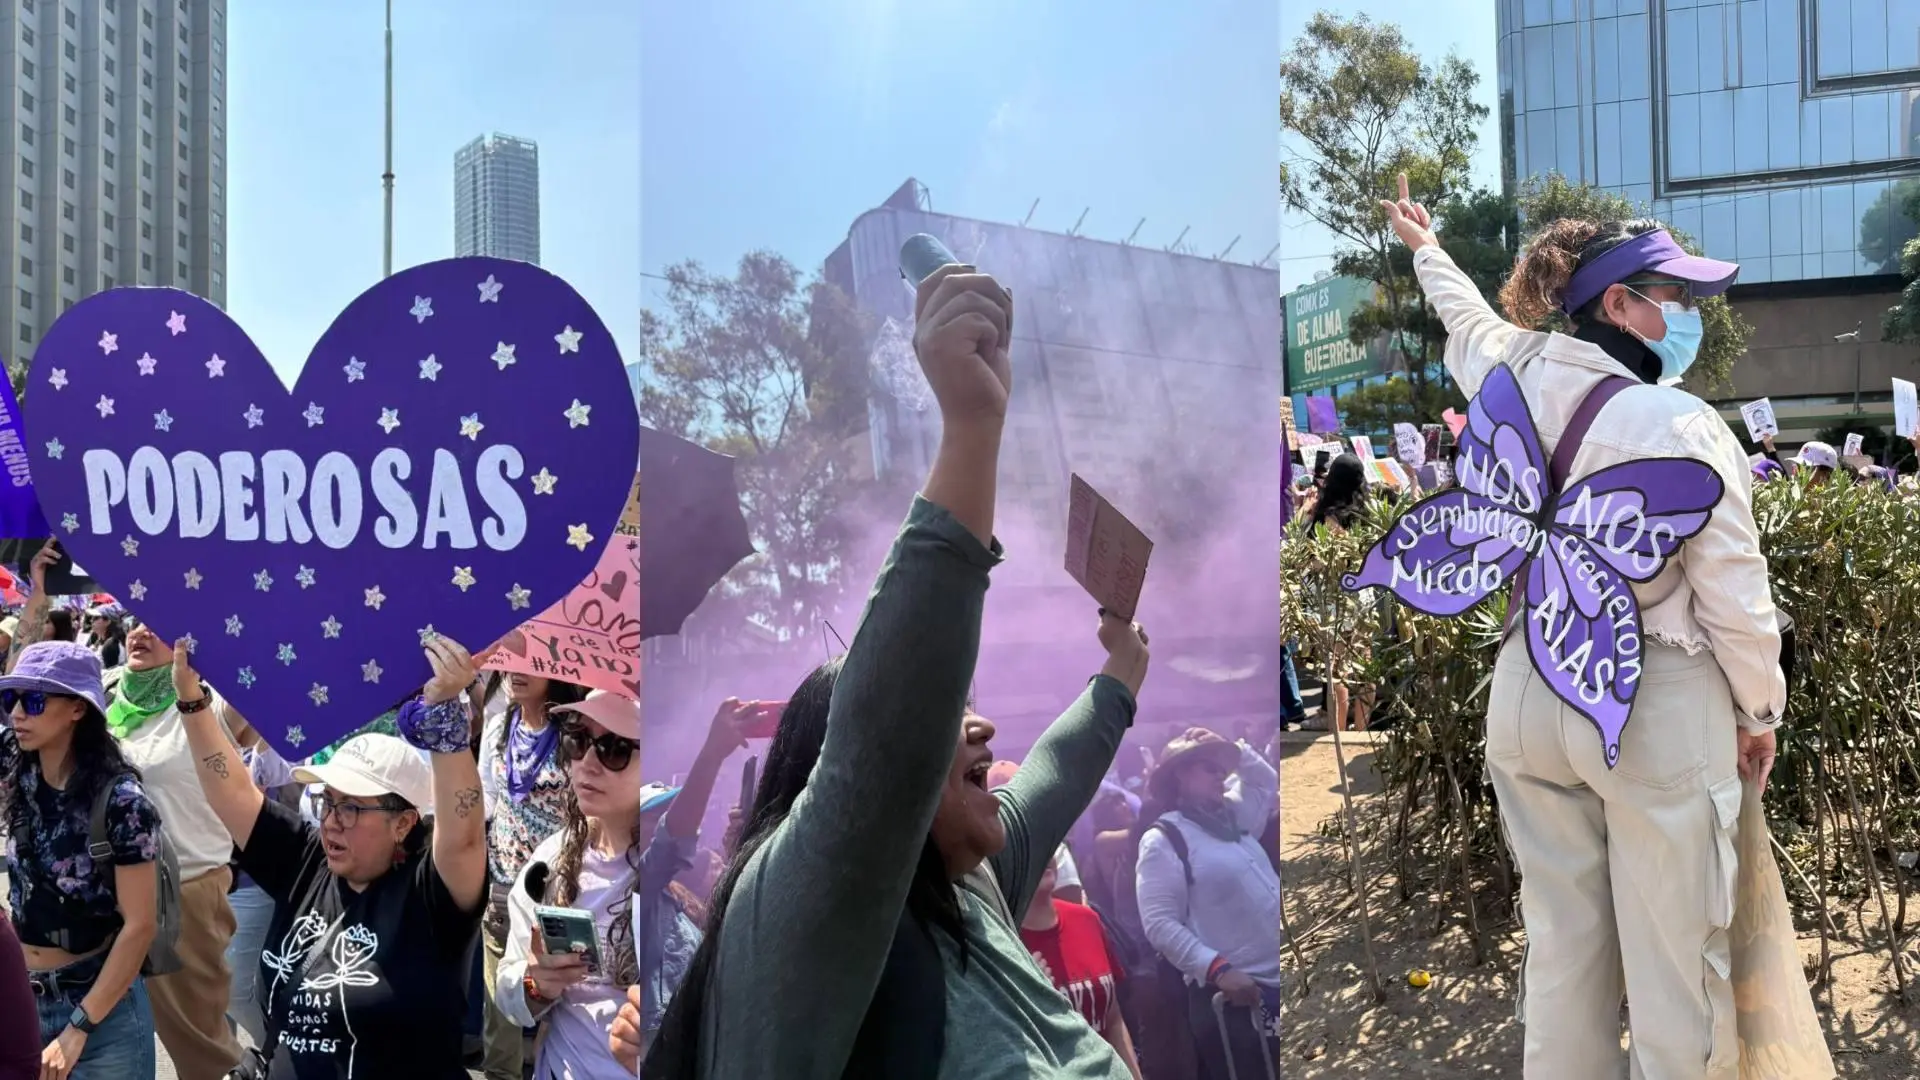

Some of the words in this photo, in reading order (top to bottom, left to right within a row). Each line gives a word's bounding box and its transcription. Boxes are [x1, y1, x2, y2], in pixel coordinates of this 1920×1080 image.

[1296, 292, 1318, 316] CDMX
[1319, 286, 1330, 308] ES
[1297, 320, 1310, 346] DE
[1312, 308, 1343, 342] ALMA
[82, 444, 527, 551] PODEROSAS
[1461, 446, 1540, 514] NOS
[1568, 485, 1675, 574] NOS
[1390, 551, 1502, 596] Miedo
[1559, 534, 1642, 685] crecieron
[531, 635, 586, 666] Ya
[531, 656, 581, 680] #8M
[1533, 587, 1615, 704] ALAS
